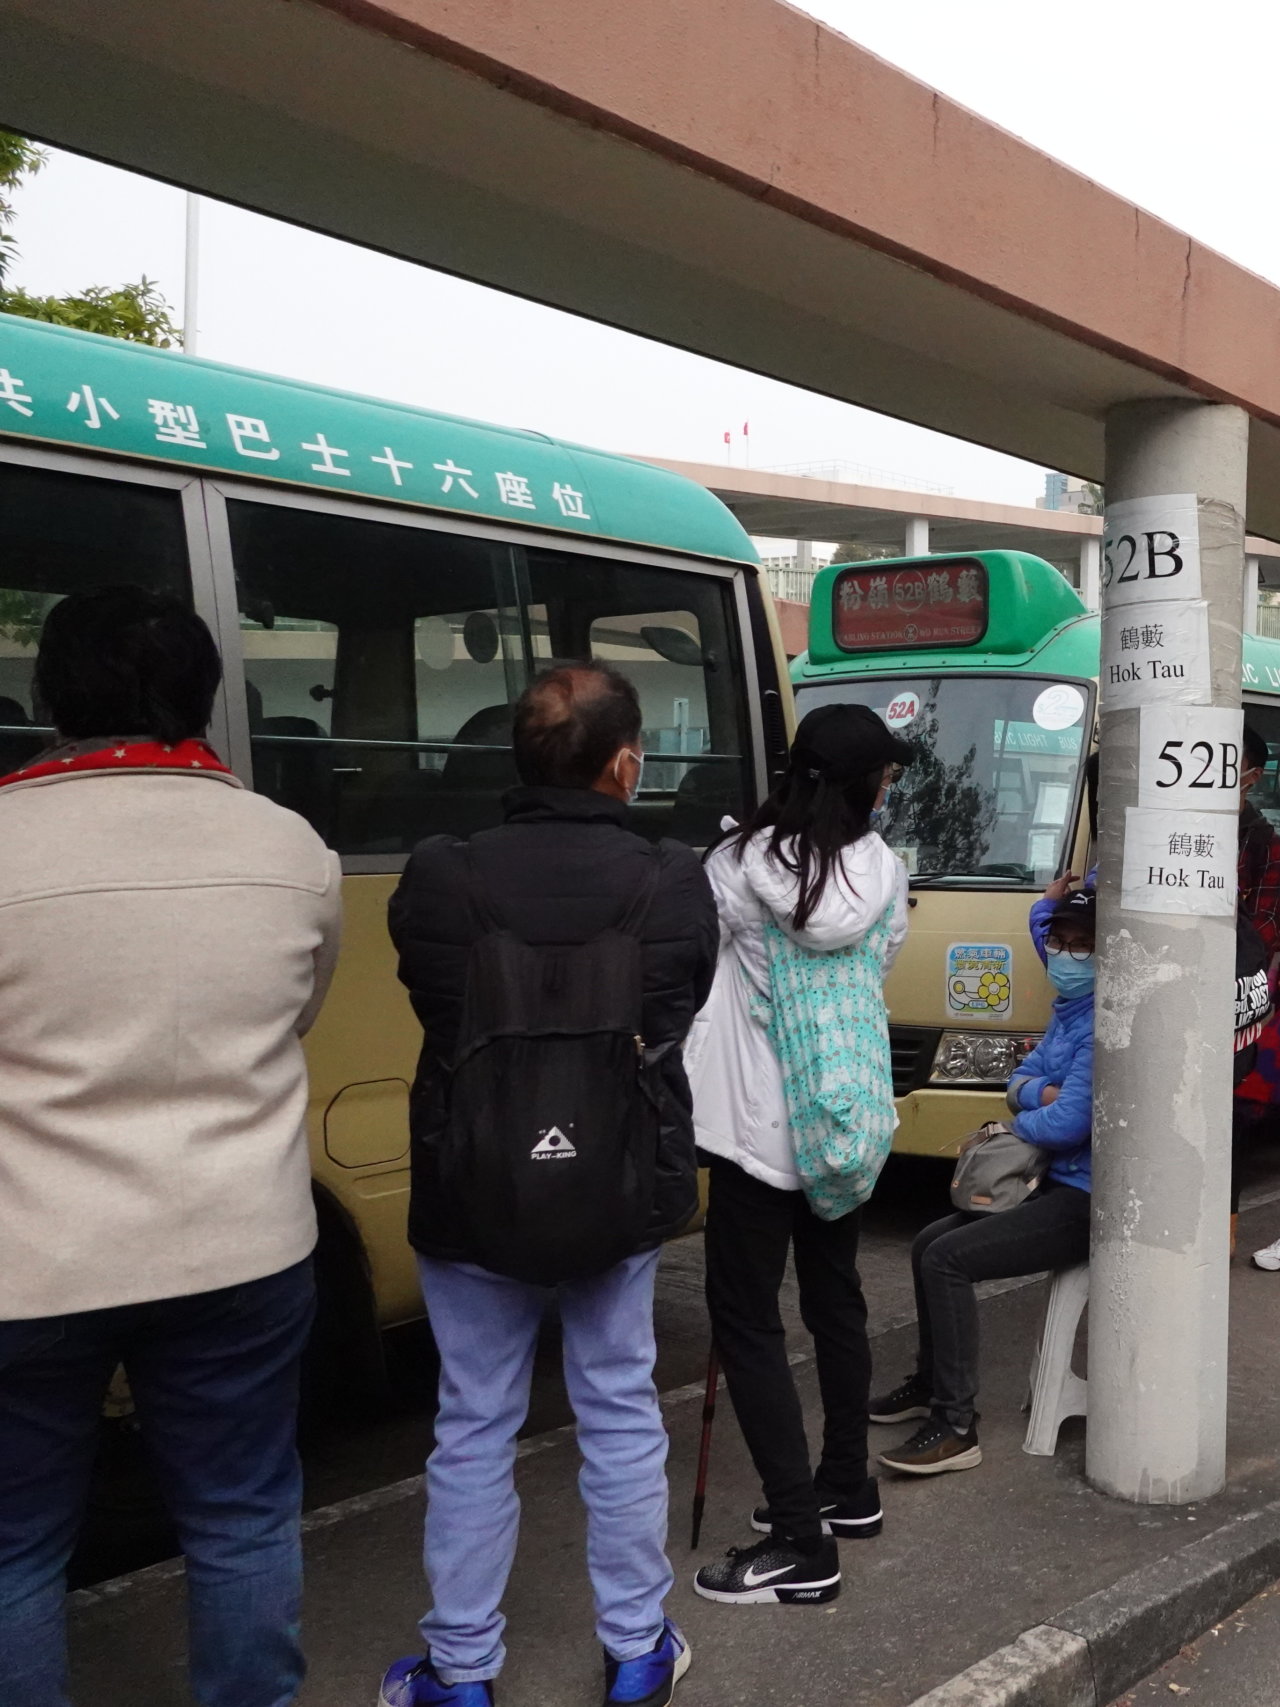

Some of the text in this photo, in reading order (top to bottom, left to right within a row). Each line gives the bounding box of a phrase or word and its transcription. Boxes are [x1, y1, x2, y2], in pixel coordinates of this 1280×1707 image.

[1103, 530, 1184, 588] 52B
[840, 575, 889, 611] 粉嶺
[895, 583, 925, 601] 52B
[1120, 624, 1164, 652] 鶴藪
[1109, 660, 1185, 684] Hok Tau
[888, 700, 915, 720] 52A
[1018, 731, 1048, 748] LIGHT
[1155, 740, 1239, 789] 52B
[1168, 831, 1215, 858] 鶴藪
[1147, 865, 1225, 889] Hok Tau
[532, 1152, 576, 1160] PLAY-KING
